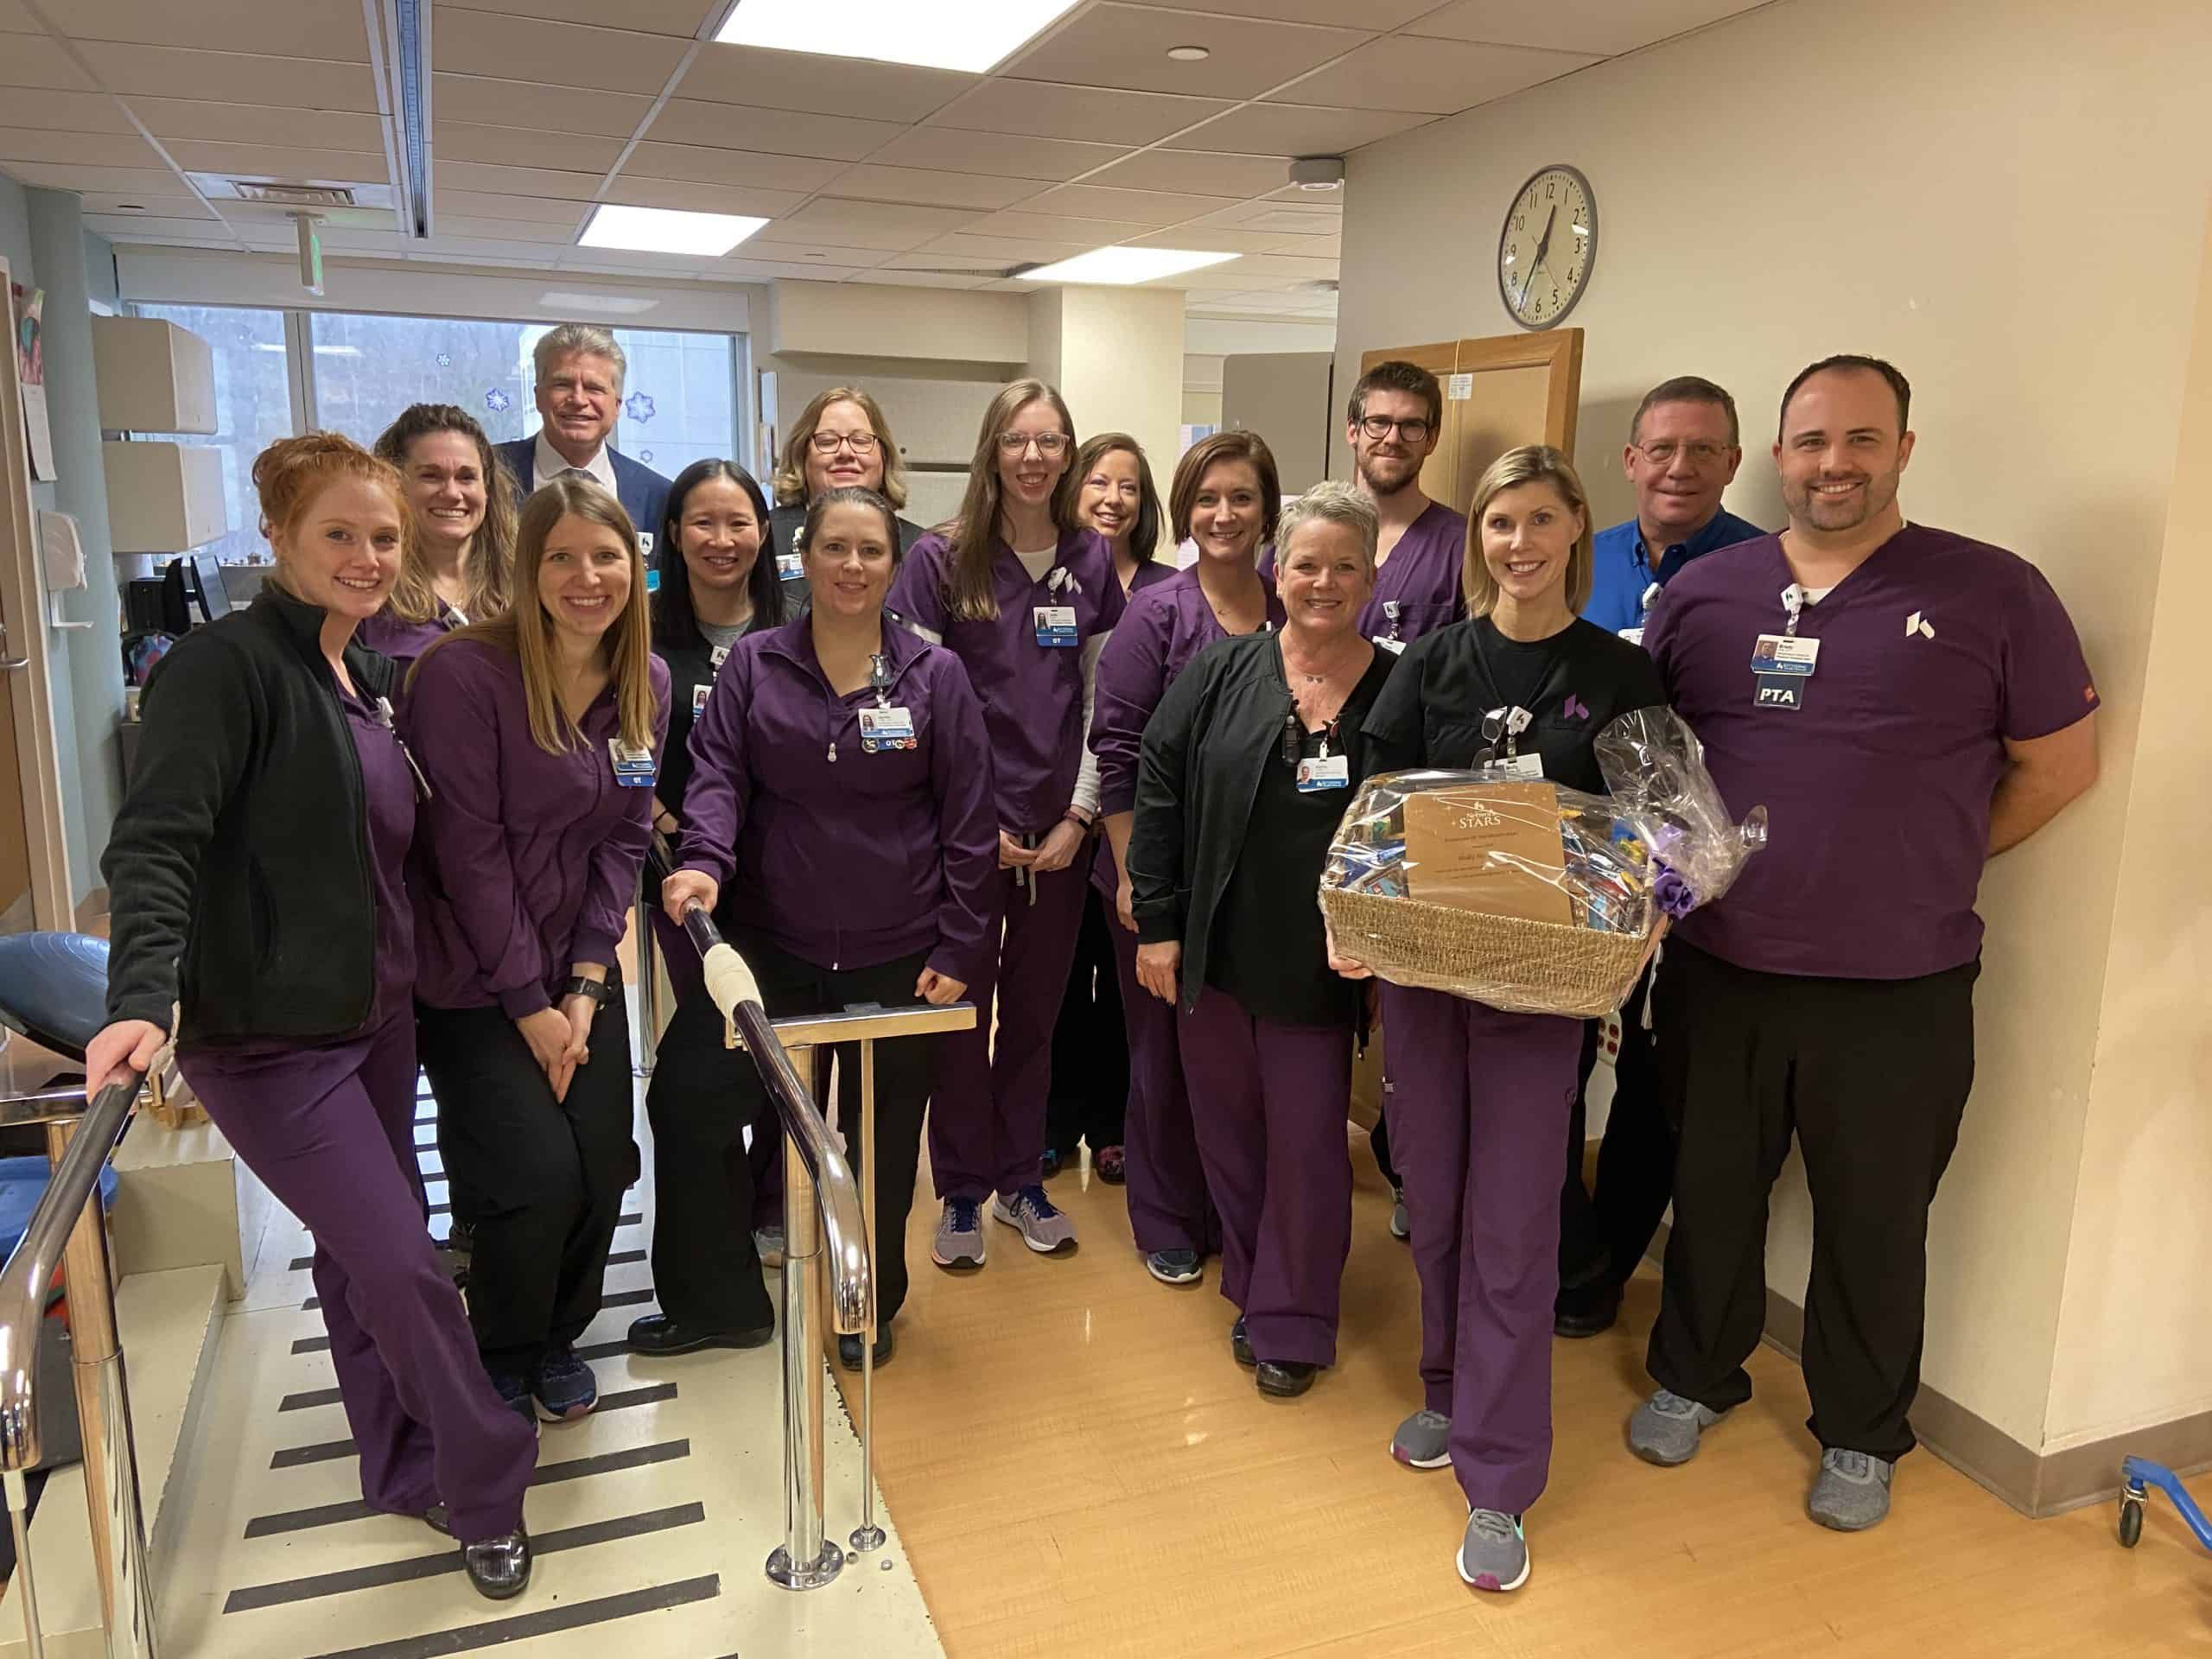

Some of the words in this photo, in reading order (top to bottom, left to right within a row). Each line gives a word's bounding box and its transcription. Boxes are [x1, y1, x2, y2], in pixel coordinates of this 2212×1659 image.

[1545, 182, 1554, 199] 12
[1564, 188, 1568, 205] 1
[1529, 193, 1538, 210] 11
[1514, 215, 1525, 232] 10
[1573, 208, 1580, 225] 2
[1510, 244, 1516, 257] 9
[1574, 238, 1580, 254] 3
[1510, 271, 1517, 286] 8
[1567, 267, 1573, 283] 4
[1552, 289, 1559, 305] 5
[1535, 298, 1541, 313] 6
[1759, 688, 1796, 704] PTA
[1459, 815, 1501, 830] STARS
